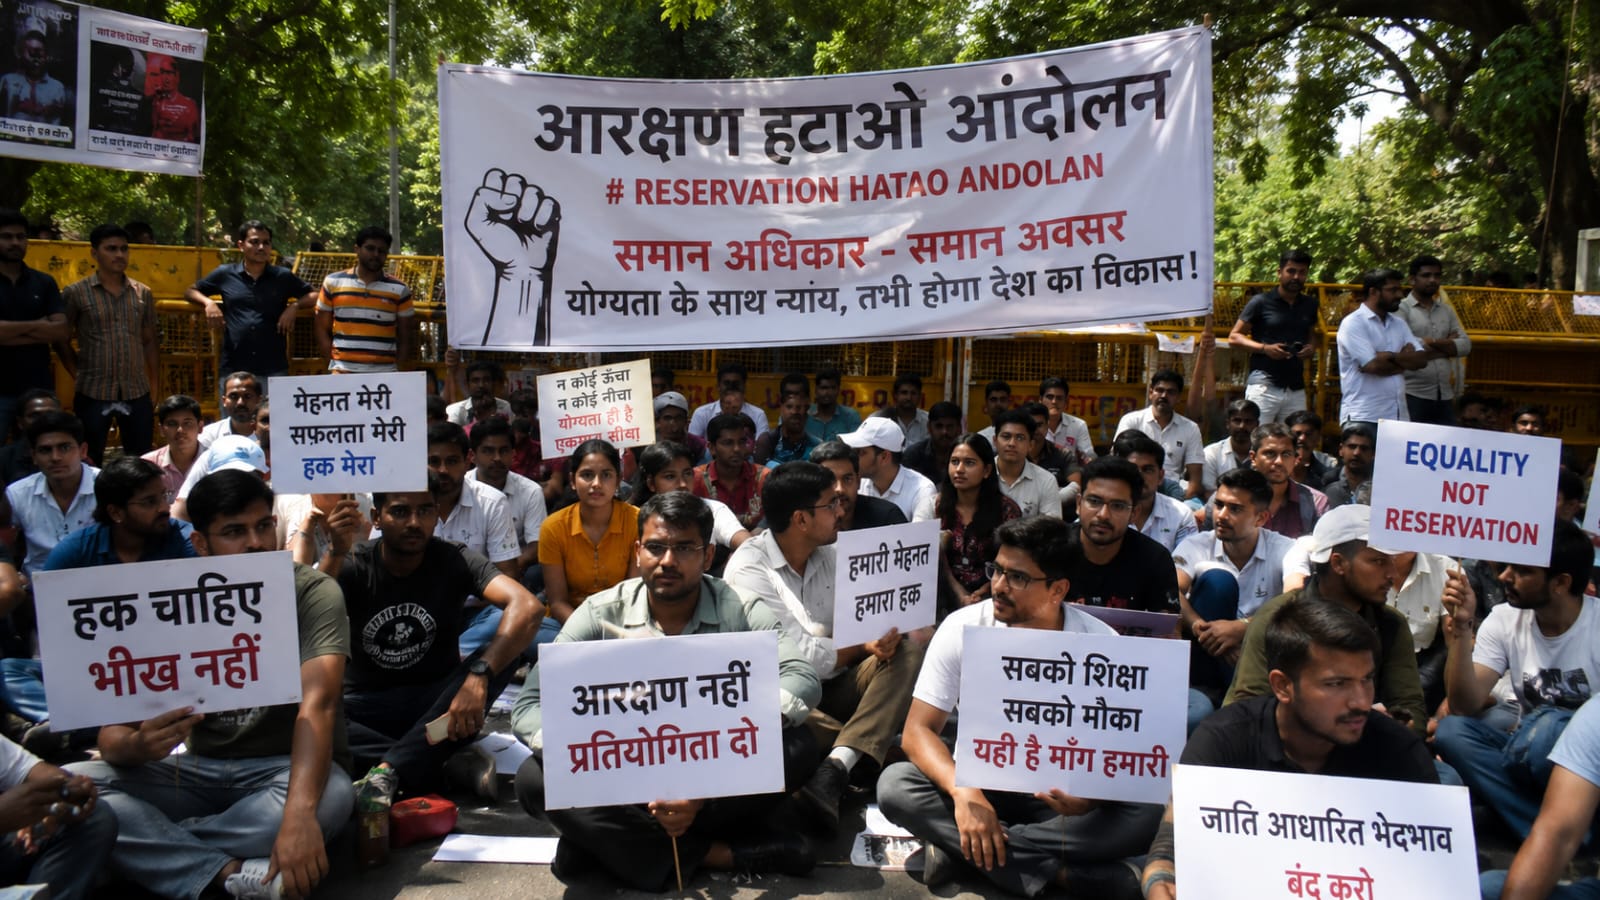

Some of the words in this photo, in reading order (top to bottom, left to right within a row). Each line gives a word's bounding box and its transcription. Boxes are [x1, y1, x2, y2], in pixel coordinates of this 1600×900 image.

[534, 104, 744, 162] आरक्षण
[760, 82, 927, 165] हटाओ
[946, 65, 1171, 142] आंदोलन
[606, 178, 624, 205] #
[635, 176, 838, 205] RESERVATION
[850, 169, 948, 201] HATAO
[958, 153, 1103, 193] ANDOLAN
[613, 240, 712, 272] समान
[725, 228, 869, 271] अधिकार
[907, 226, 1005, 264] समान
[1018, 211, 1127, 250] अवसर
[565, 281, 661, 316] योग्यता
[669, 281, 698, 316] के
[708, 289, 767, 316] साथ
[856, 274, 912, 310] तभी
[920, 272, 981, 308] होगा
[990, 266, 1036, 300] देश
[1046, 266, 1084, 293] का
[293, 387, 351, 415] मेहनत
[356, 384, 392, 410] मेरी
[556, 379, 566, 391] न
[571, 370, 597, 389] कोई
[557, 398, 568, 410] न
[571, 391, 597, 408] कोई
[602, 387, 632, 403] नीचा
[371, 416, 406, 442] मेरी
[558, 413, 601, 430] योग्यता
[606, 407, 620, 426] ही
[624, 404, 634, 423] है
[302, 457, 335, 480] हक
[341, 450, 376, 476] मेरा
[1405, 441, 1529, 477] EQUALITY
[1441, 480, 1489, 506] NOT
[1385, 508, 1539, 546] RESERVATION
[848, 542, 890, 582] हमारी
[893, 540, 930, 572] मेहनत
[68, 593, 139, 640] हक
[148, 572, 264, 626] चाहिए
[855, 589, 895, 622] हमारा
[899, 583, 922, 612] हक
[88, 645, 181, 697] भीख
[190, 632, 262, 689] नहीं
[1001, 652, 1076, 685] सबको
[1083, 653, 1149, 692] शिक्षा
[571, 676, 688, 716] आरक्षण
[696, 659, 751, 708] नहीं
[1002, 695, 1075, 728] सबको
[1082, 696, 1143, 732] मौका
[568, 724, 720, 774] प्रतियोगिता
[728, 716, 759, 759] दो
[973, 732, 1018, 769] यही
[1024, 734, 1042, 772] है
[1049, 736, 1096, 772] माँग
[1103, 745, 1169, 778] हमारी
[1200, 800, 1258, 836] जाति
[1268, 808, 1365, 846] आधारित
[1372, 812, 1452, 853] भेदभाव
[1285, 863, 1321, 900] बंद
[1327, 867, 1374, 900] करो
